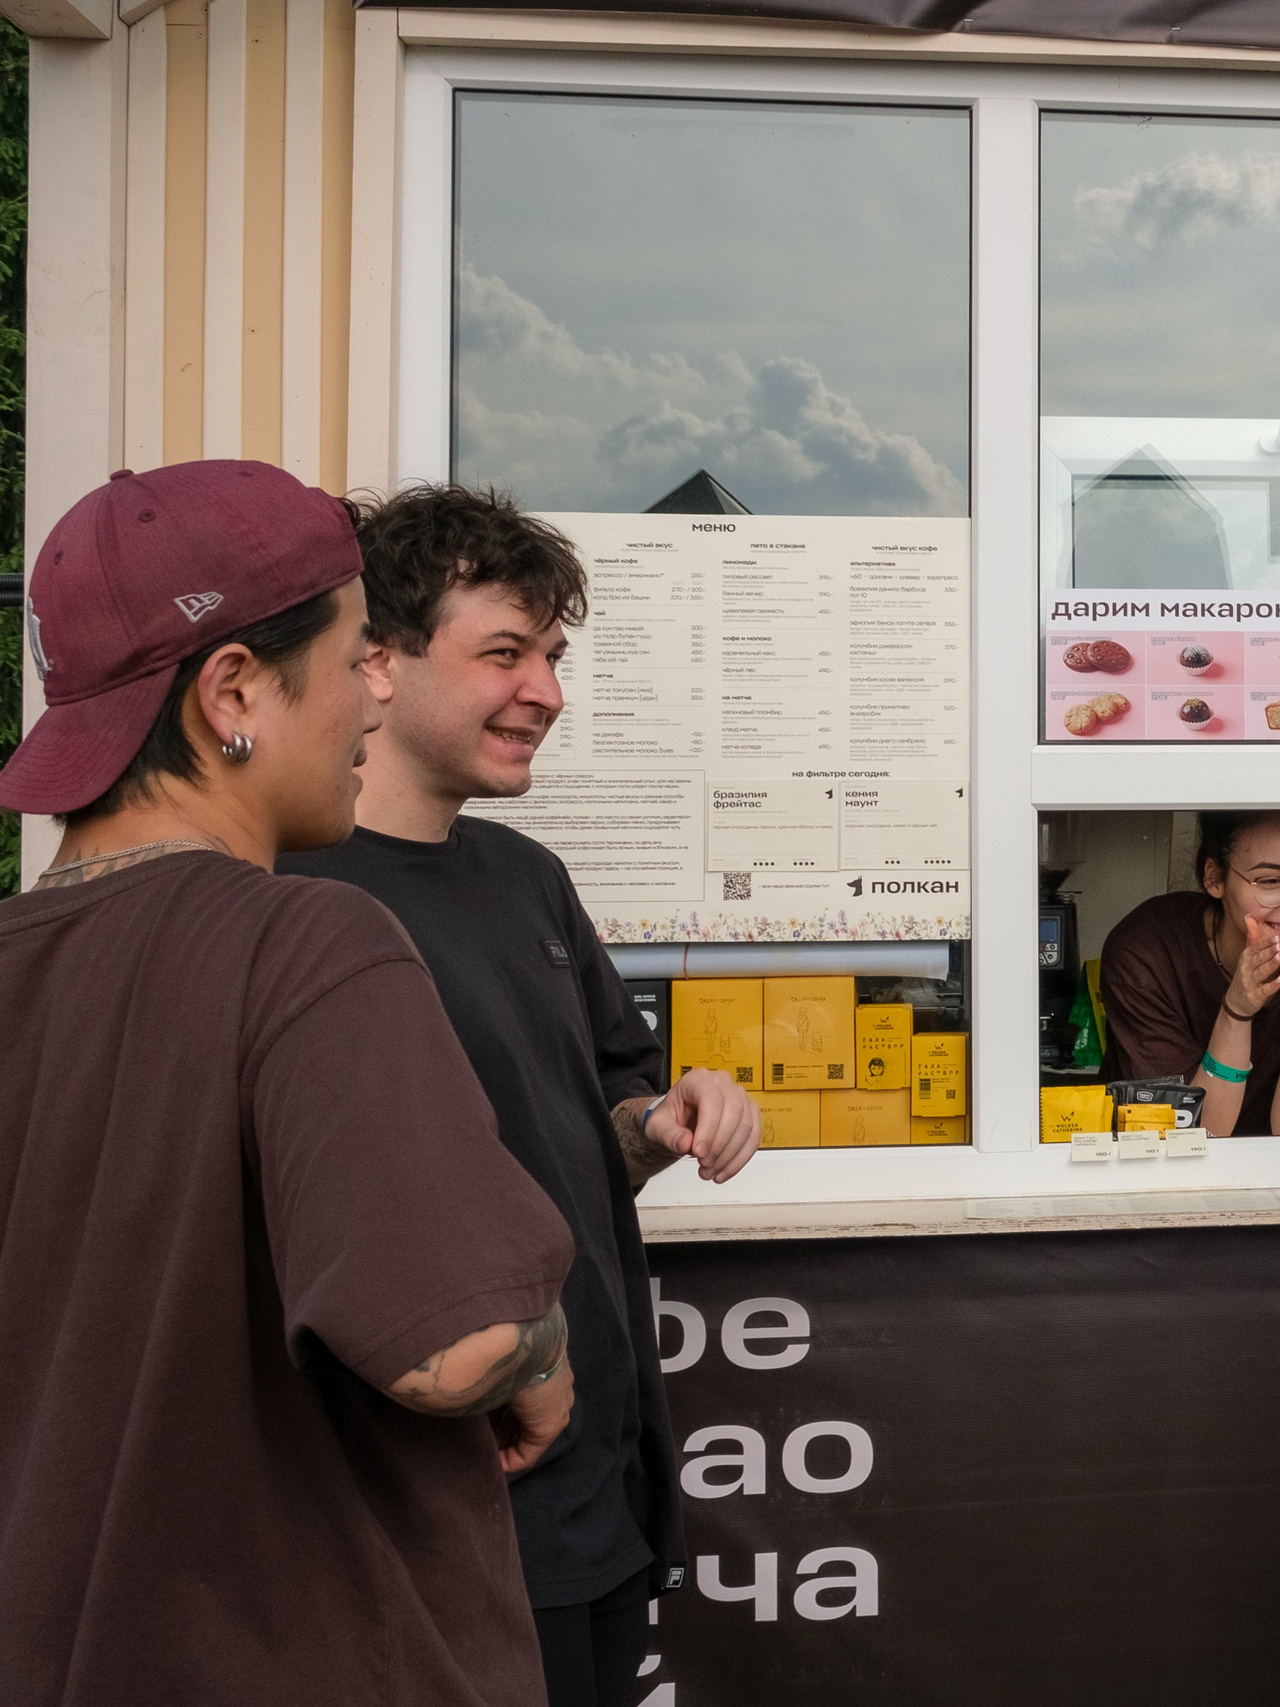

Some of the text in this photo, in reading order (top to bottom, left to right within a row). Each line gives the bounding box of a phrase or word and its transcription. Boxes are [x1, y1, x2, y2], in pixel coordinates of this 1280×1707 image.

[692, 524, 736, 532] меню
[1051, 601, 1150, 622] дарим
[713, 800, 762, 809] фрейтас
[872, 881, 958, 893] полкан
